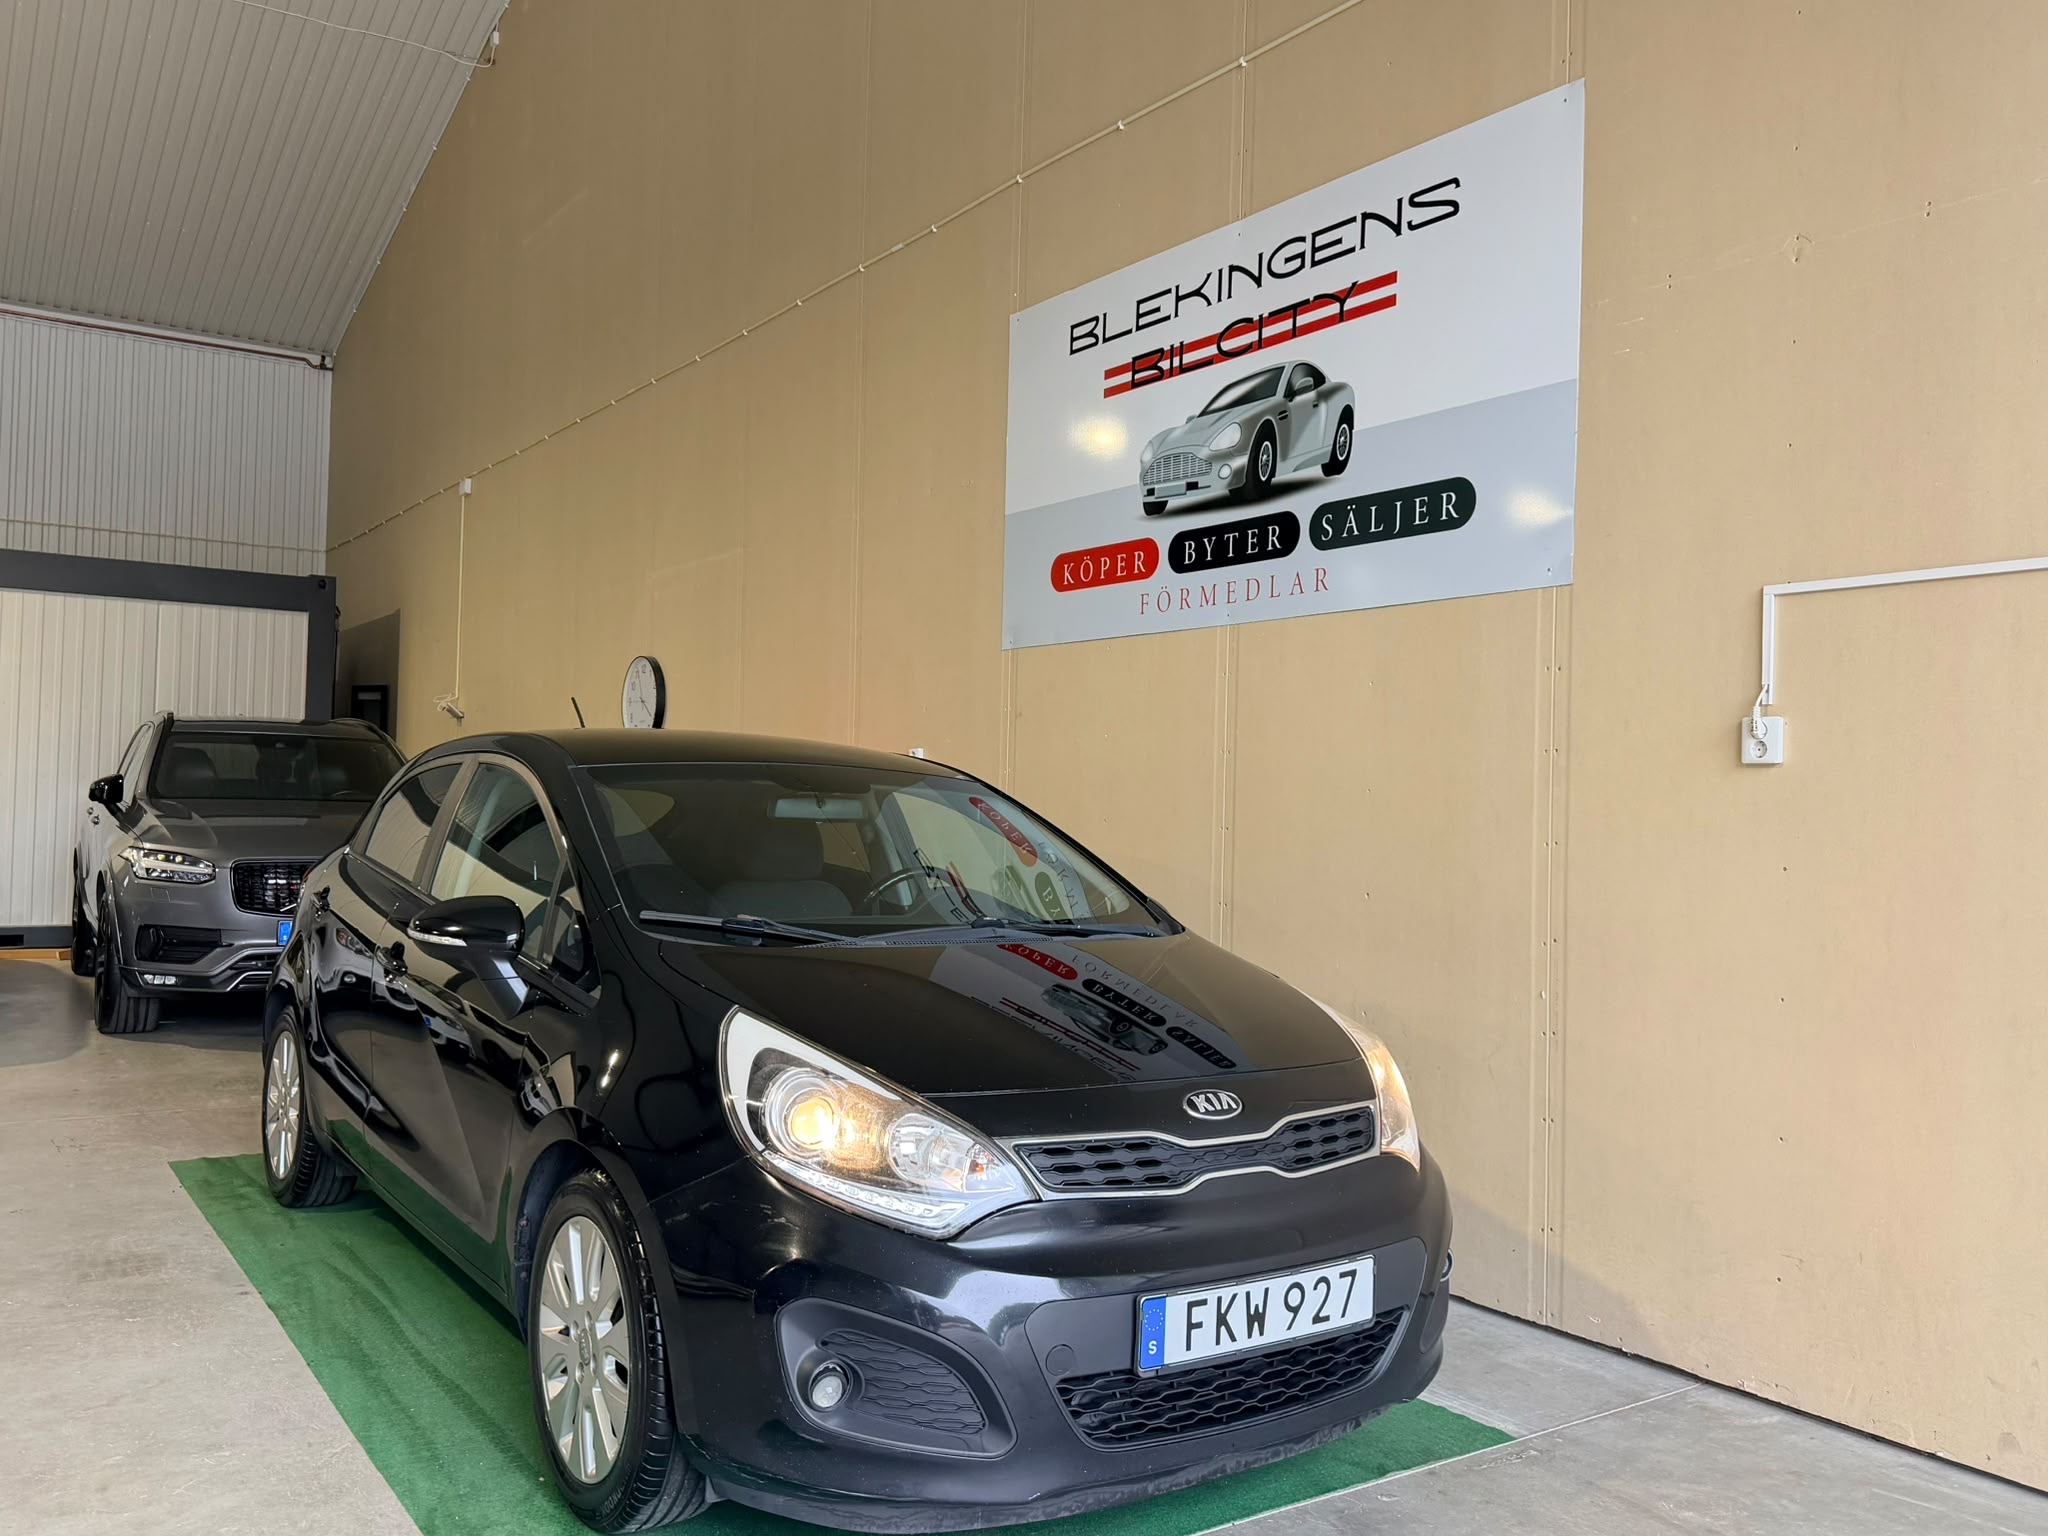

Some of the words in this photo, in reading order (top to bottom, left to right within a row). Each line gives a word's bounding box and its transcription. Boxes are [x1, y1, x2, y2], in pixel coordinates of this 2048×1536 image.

[1069, 177, 1461, 356] BLEKINGENS
[1131, 281, 1359, 389] BILCITY
[1062, 550, 1146, 585] KÖPER
[1184, 525, 1281, 564] BYTER
[1321, 490, 1460, 541] SÄLJER
[1139, 566, 1329, 616] FÖRMEDLAR
[1190, 1094, 1236, 1113] KIA
[1148, 1340, 1157, 1355] S
[1185, 1287, 1269, 1352] FKW
[1284, 1268, 1357, 1331] 927
